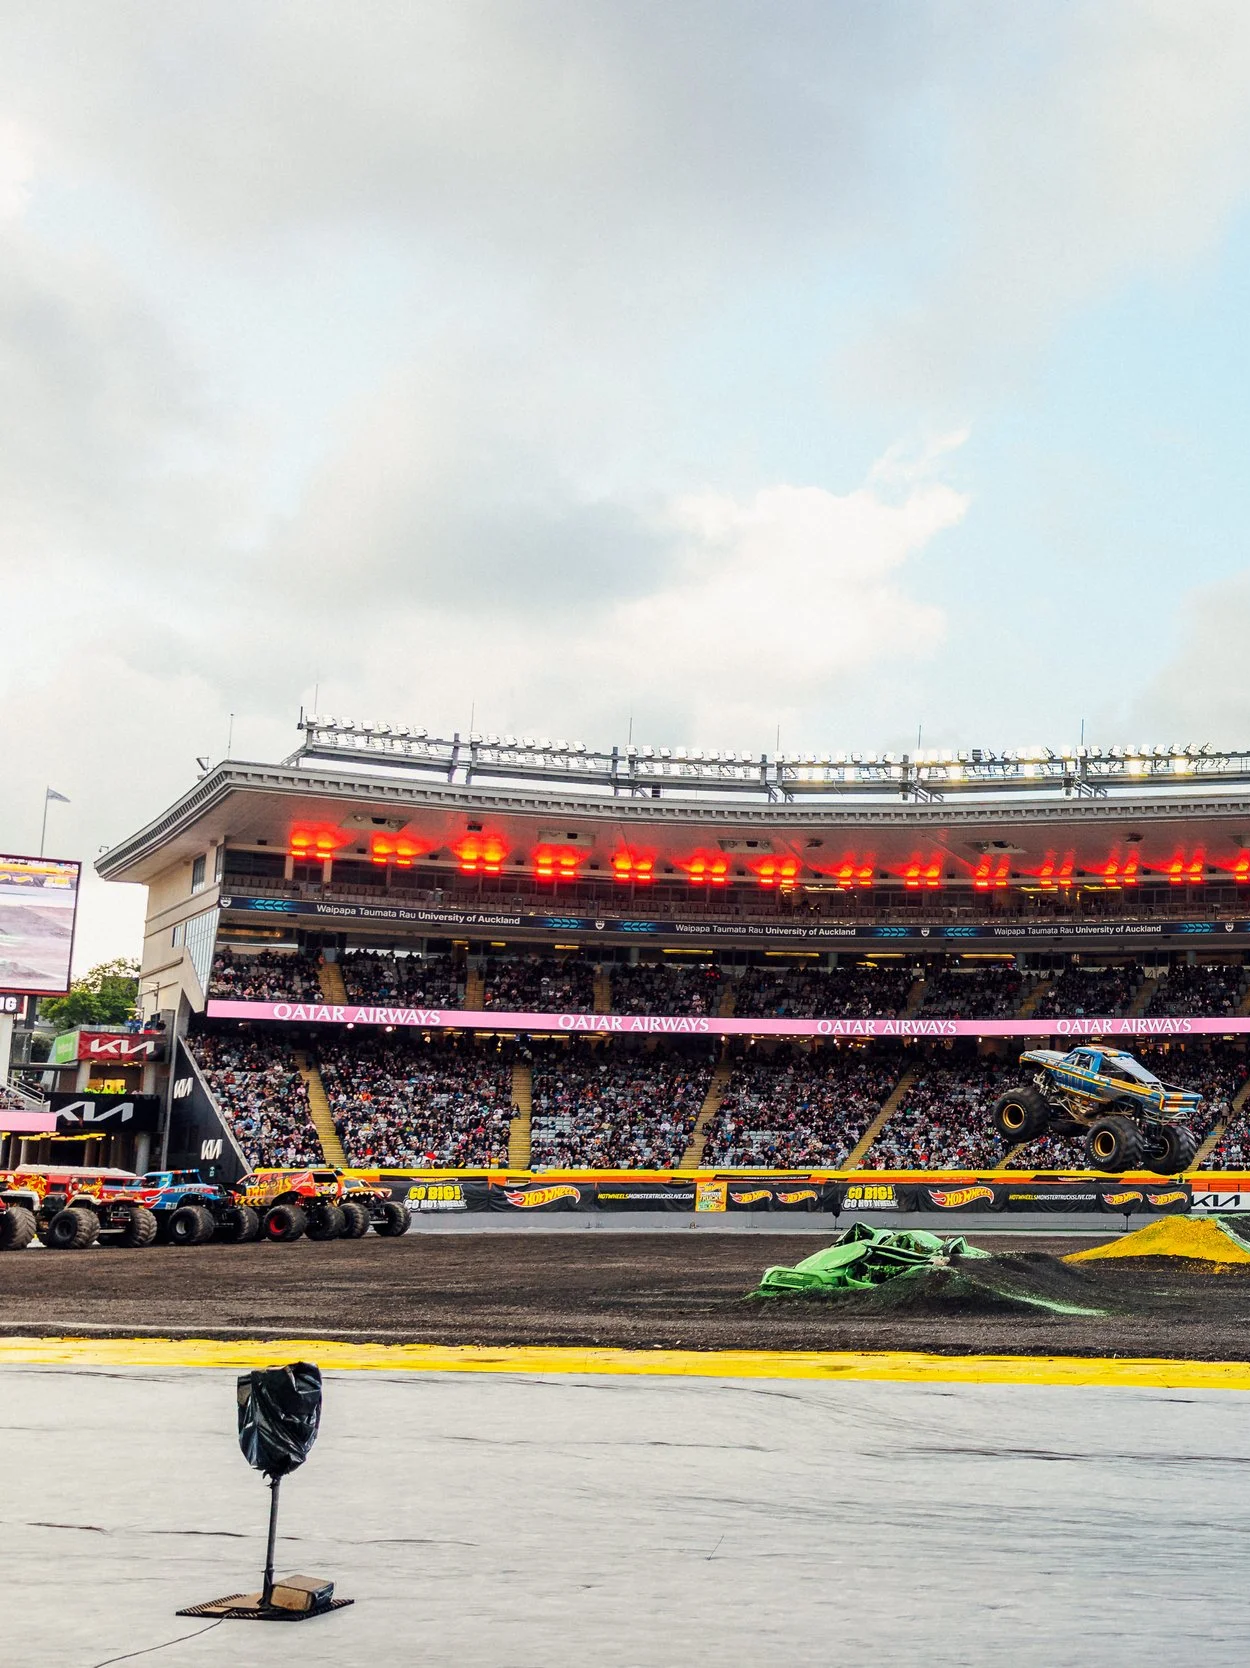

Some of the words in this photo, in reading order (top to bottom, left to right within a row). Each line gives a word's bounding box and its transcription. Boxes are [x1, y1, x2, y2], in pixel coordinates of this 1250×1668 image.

[316, 904, 356, 916] Waipapa
[359, 908, 397, 918] Taumata
[399, 911, 416, 920] Rau
[418, 912, 464, 924] University
[466, 915, 477, 923] of
[478, 915, 520, 925] Auckland
[675, 924, 710, 933] Waipapa
[712, 925, 746, 933] Taumata
[749, 926, 764, 934] Rau
[765, 926, 807, 937] University
[818, 928, 856, 936] Auckland
[994, 928, 1026, 936] Waipapa
[1060, 926, 1074, 934] Rau
[1075, 925, 1114, 935] University
[1116, 925, 1125, 933] of
[1125, 925, 1162, 933] Auckland
[273, 1003, 345, 1021] QATAR
[354, 1007, 441, 1025] AIRWAYS
[558, 1014, 622, 1031] QATAR
[631, 1016, 709, 1033] AIRWAYS
[817, 1020, 876, 1035] QATAR
[883, 1020, 956, 1035] AIRWAYS
[1056, 1019, 1113, 1034] QATAR
[1120, 1018, 1192, 1033] AIRWAYS
[90, 1039, 155, 1055] KIA
[173, 1077, 194, 1099] KIA
[200, 1139, 223, 1160] KIA
[409, 1186, 426, 1200] GO
[427, 1185, 461, 1200] BIG!
[524, 1190, 545, 1206] HOT
[848, 1186, 863, 1200] GO
[864, 1186, 893, 1200] BIG!
[945, 1193, 962, 1206] HOT
[405, 1199, 420, 1209] GO
[420, 1200, 438, 1209] HOT
[844, 1199, 857, 1209] GO
[859, 1200, 873, 1208] HOT
[1192, 1194, 1241, 1207] KIA
